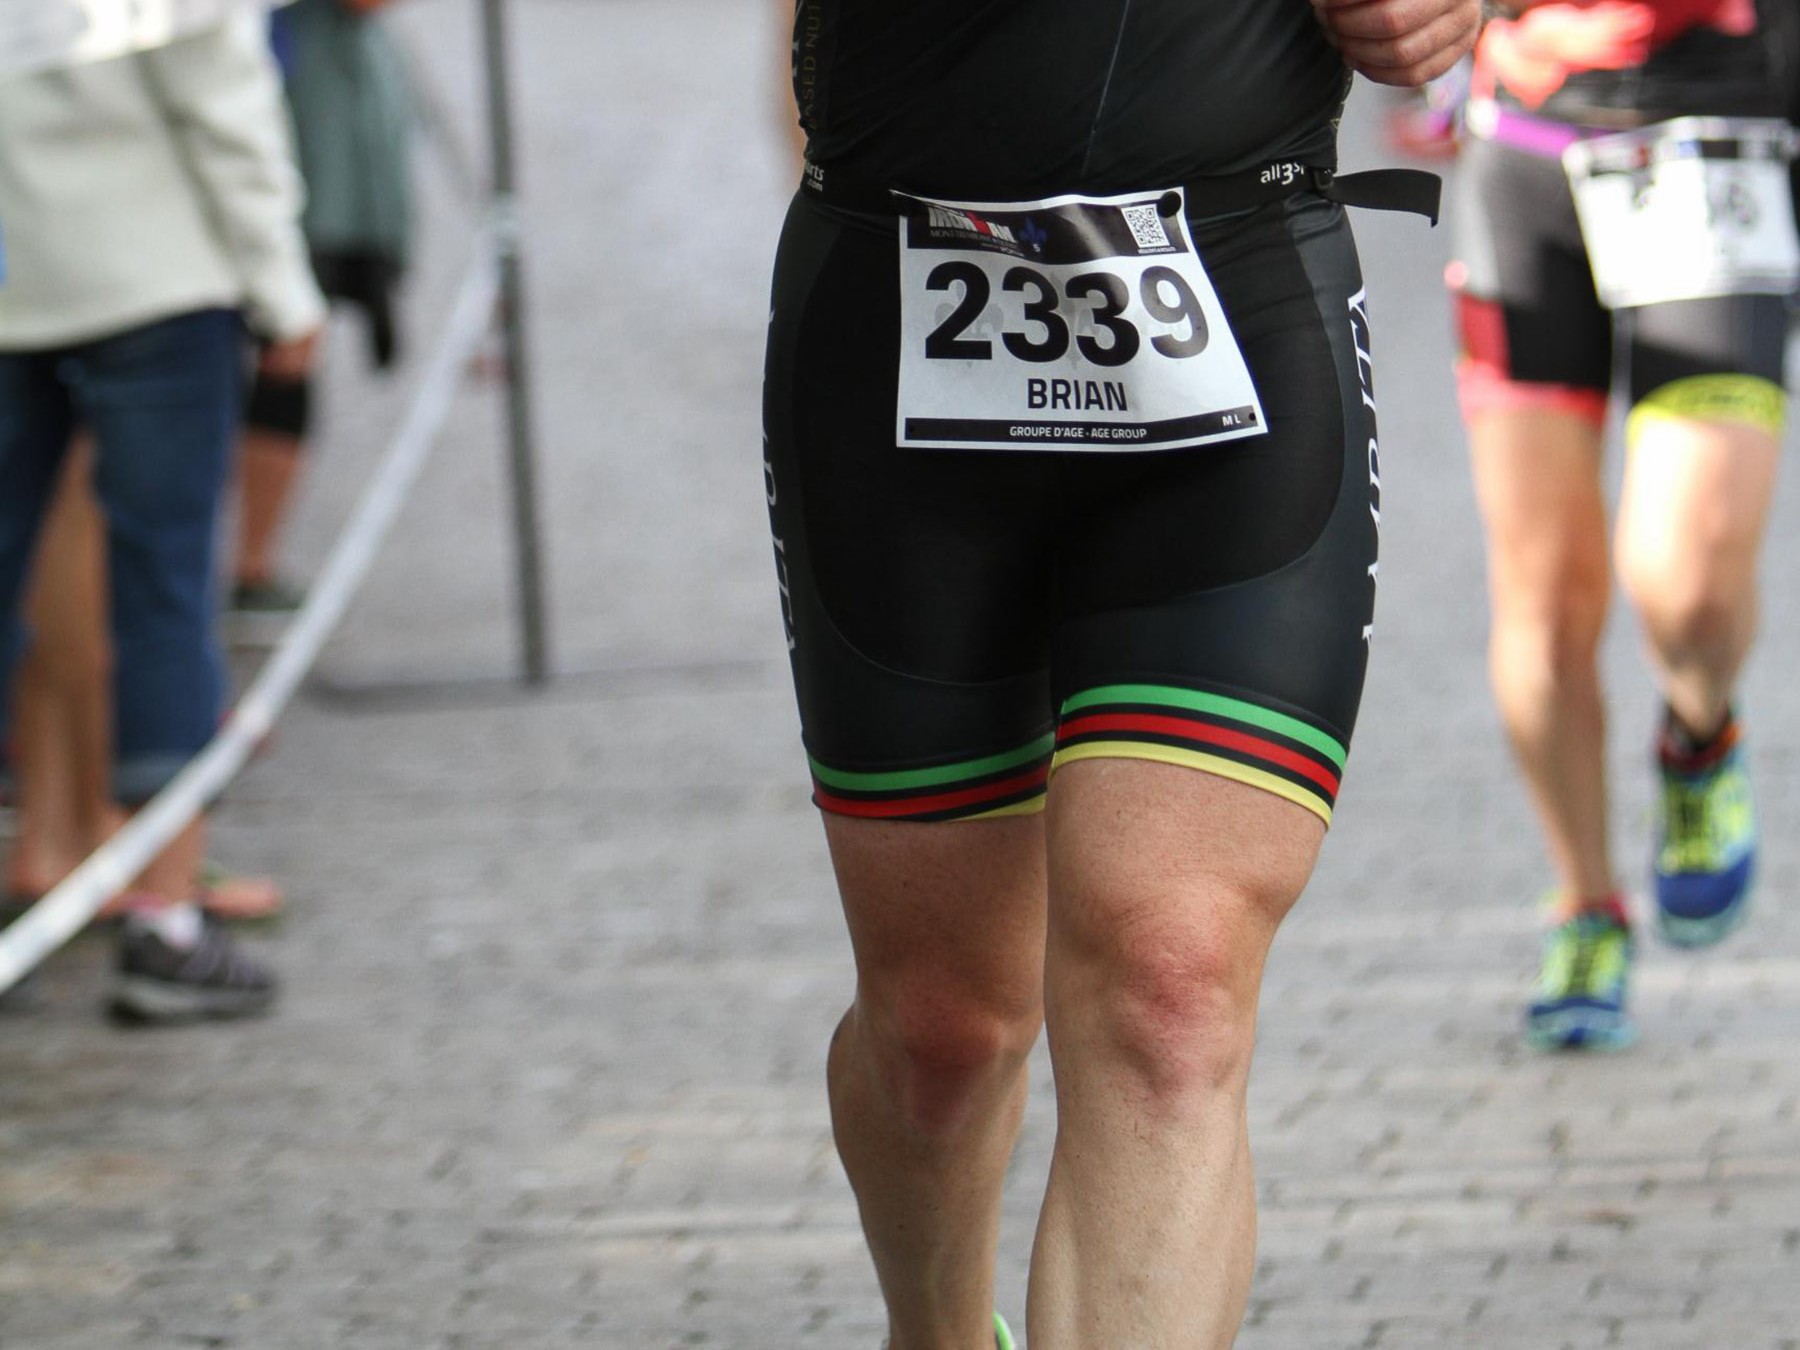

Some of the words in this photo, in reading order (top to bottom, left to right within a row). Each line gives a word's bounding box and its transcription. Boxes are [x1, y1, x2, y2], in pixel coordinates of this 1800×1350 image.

[925, 261, 1209, 367] 2339
[1027, 378, 1128, 411] BRIAN
[1009, 426, 1052, 437] GROUPE
[1053, 427, 1084, 438] D'AGE
[1090, 428, 1110, 438] AGE
[1111, 428, 1148, 439] GROUP
